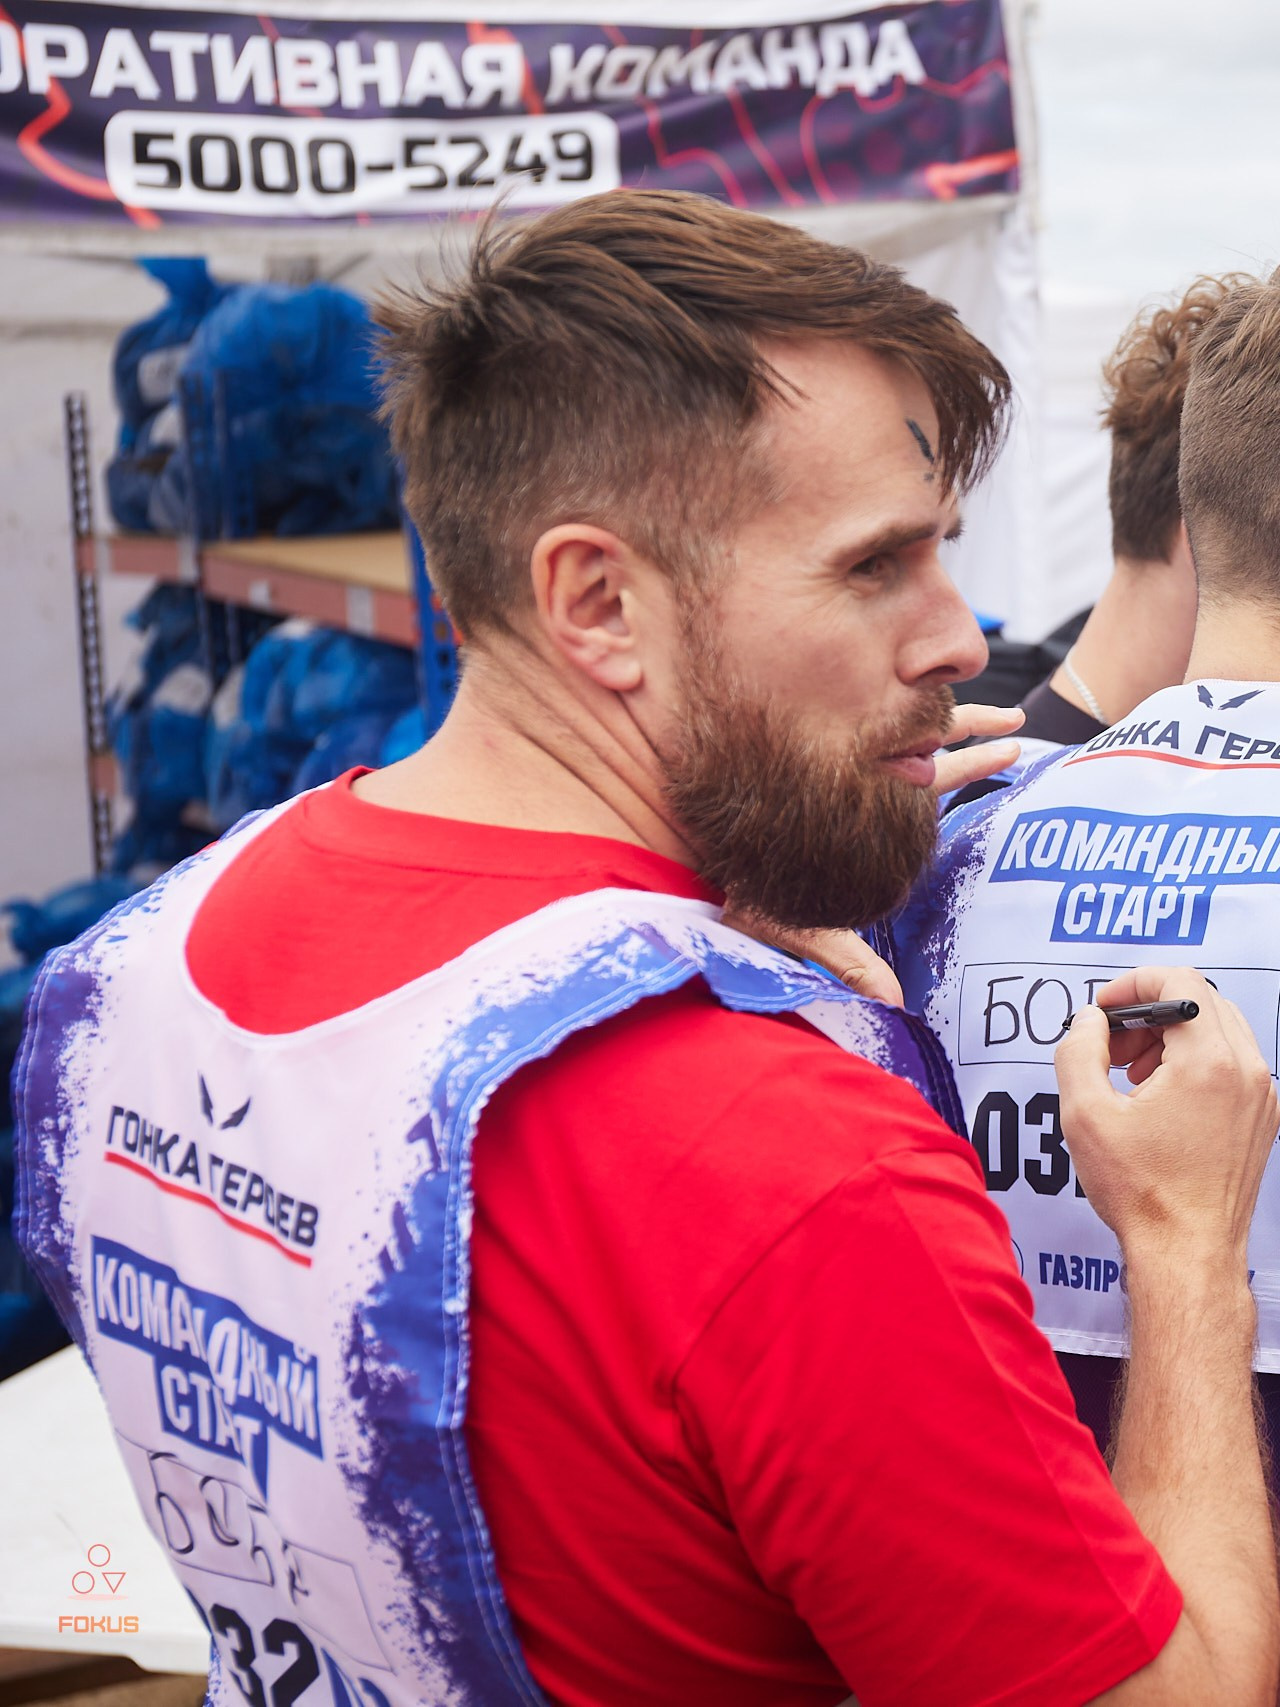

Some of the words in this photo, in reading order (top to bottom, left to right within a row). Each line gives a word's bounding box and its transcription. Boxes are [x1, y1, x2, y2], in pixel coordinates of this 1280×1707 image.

[546, 18, 926, 104] КОМАНДА
[133, 129, 594, 194] 5000-5249
[1060, 883, 1207, 938] СТАРТ
[107, 1105, 200, 1186] ГОНКА
[208, 1152, 320, 1248] ГЕРОЕВ
